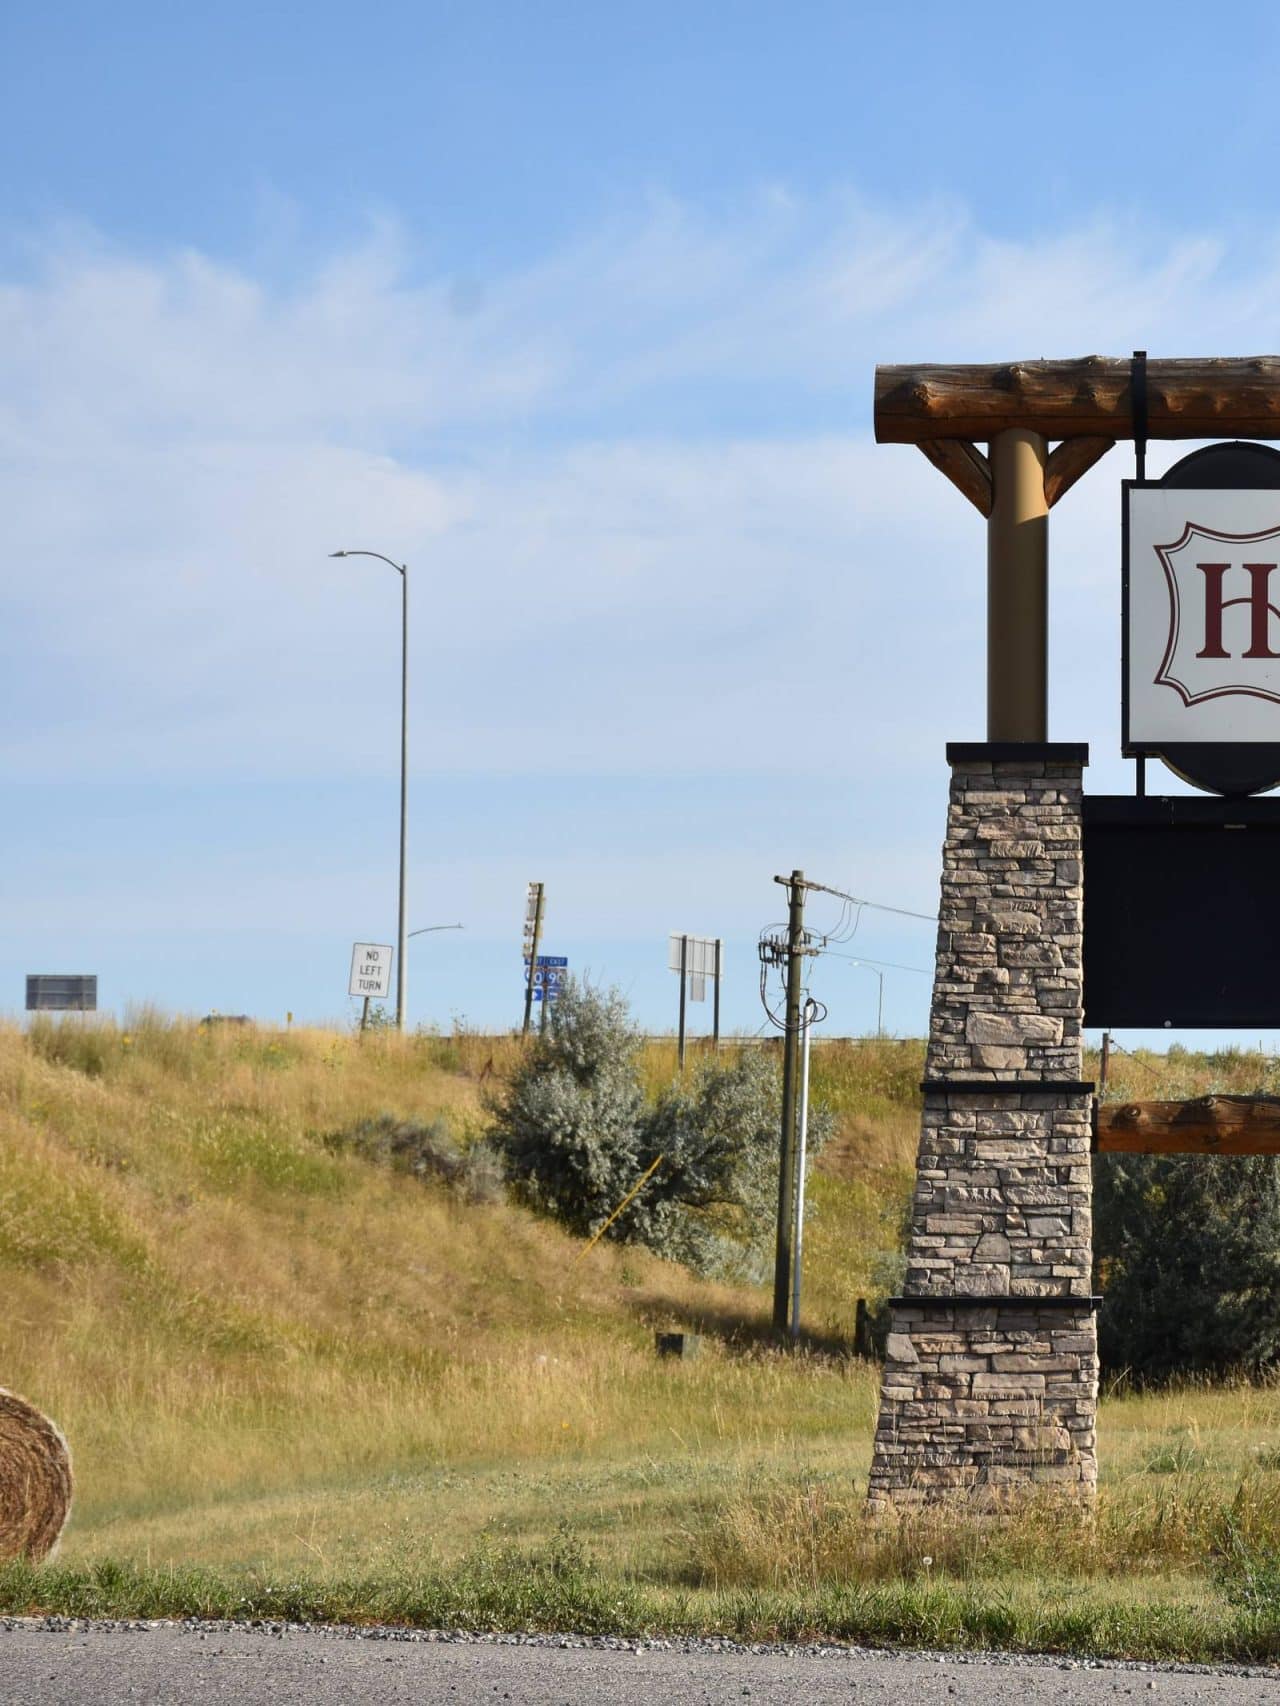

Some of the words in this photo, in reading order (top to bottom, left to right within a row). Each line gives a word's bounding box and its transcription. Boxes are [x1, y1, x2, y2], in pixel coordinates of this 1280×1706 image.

[365, 951, 380, 961] NO
[359, 965, 383, 976] LEFT
[358, 979, 382, 992] TURN
